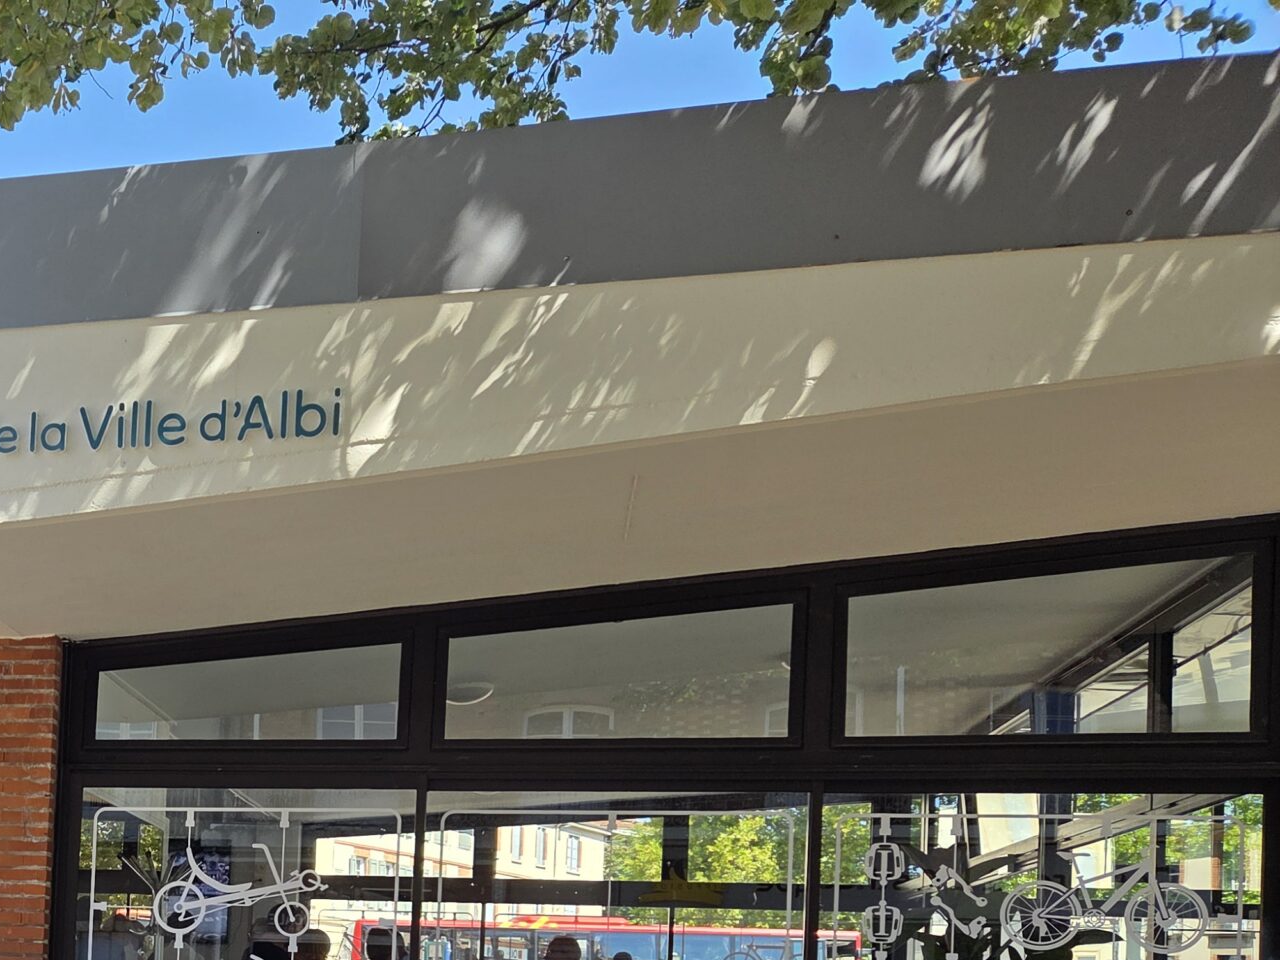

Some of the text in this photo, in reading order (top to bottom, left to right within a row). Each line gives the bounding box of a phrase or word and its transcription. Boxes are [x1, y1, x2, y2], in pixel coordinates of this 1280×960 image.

[29, 411, 68, 452] la
[80, 399, 186, 450] Ville
[200, 387, 342, 441] d'Albi
